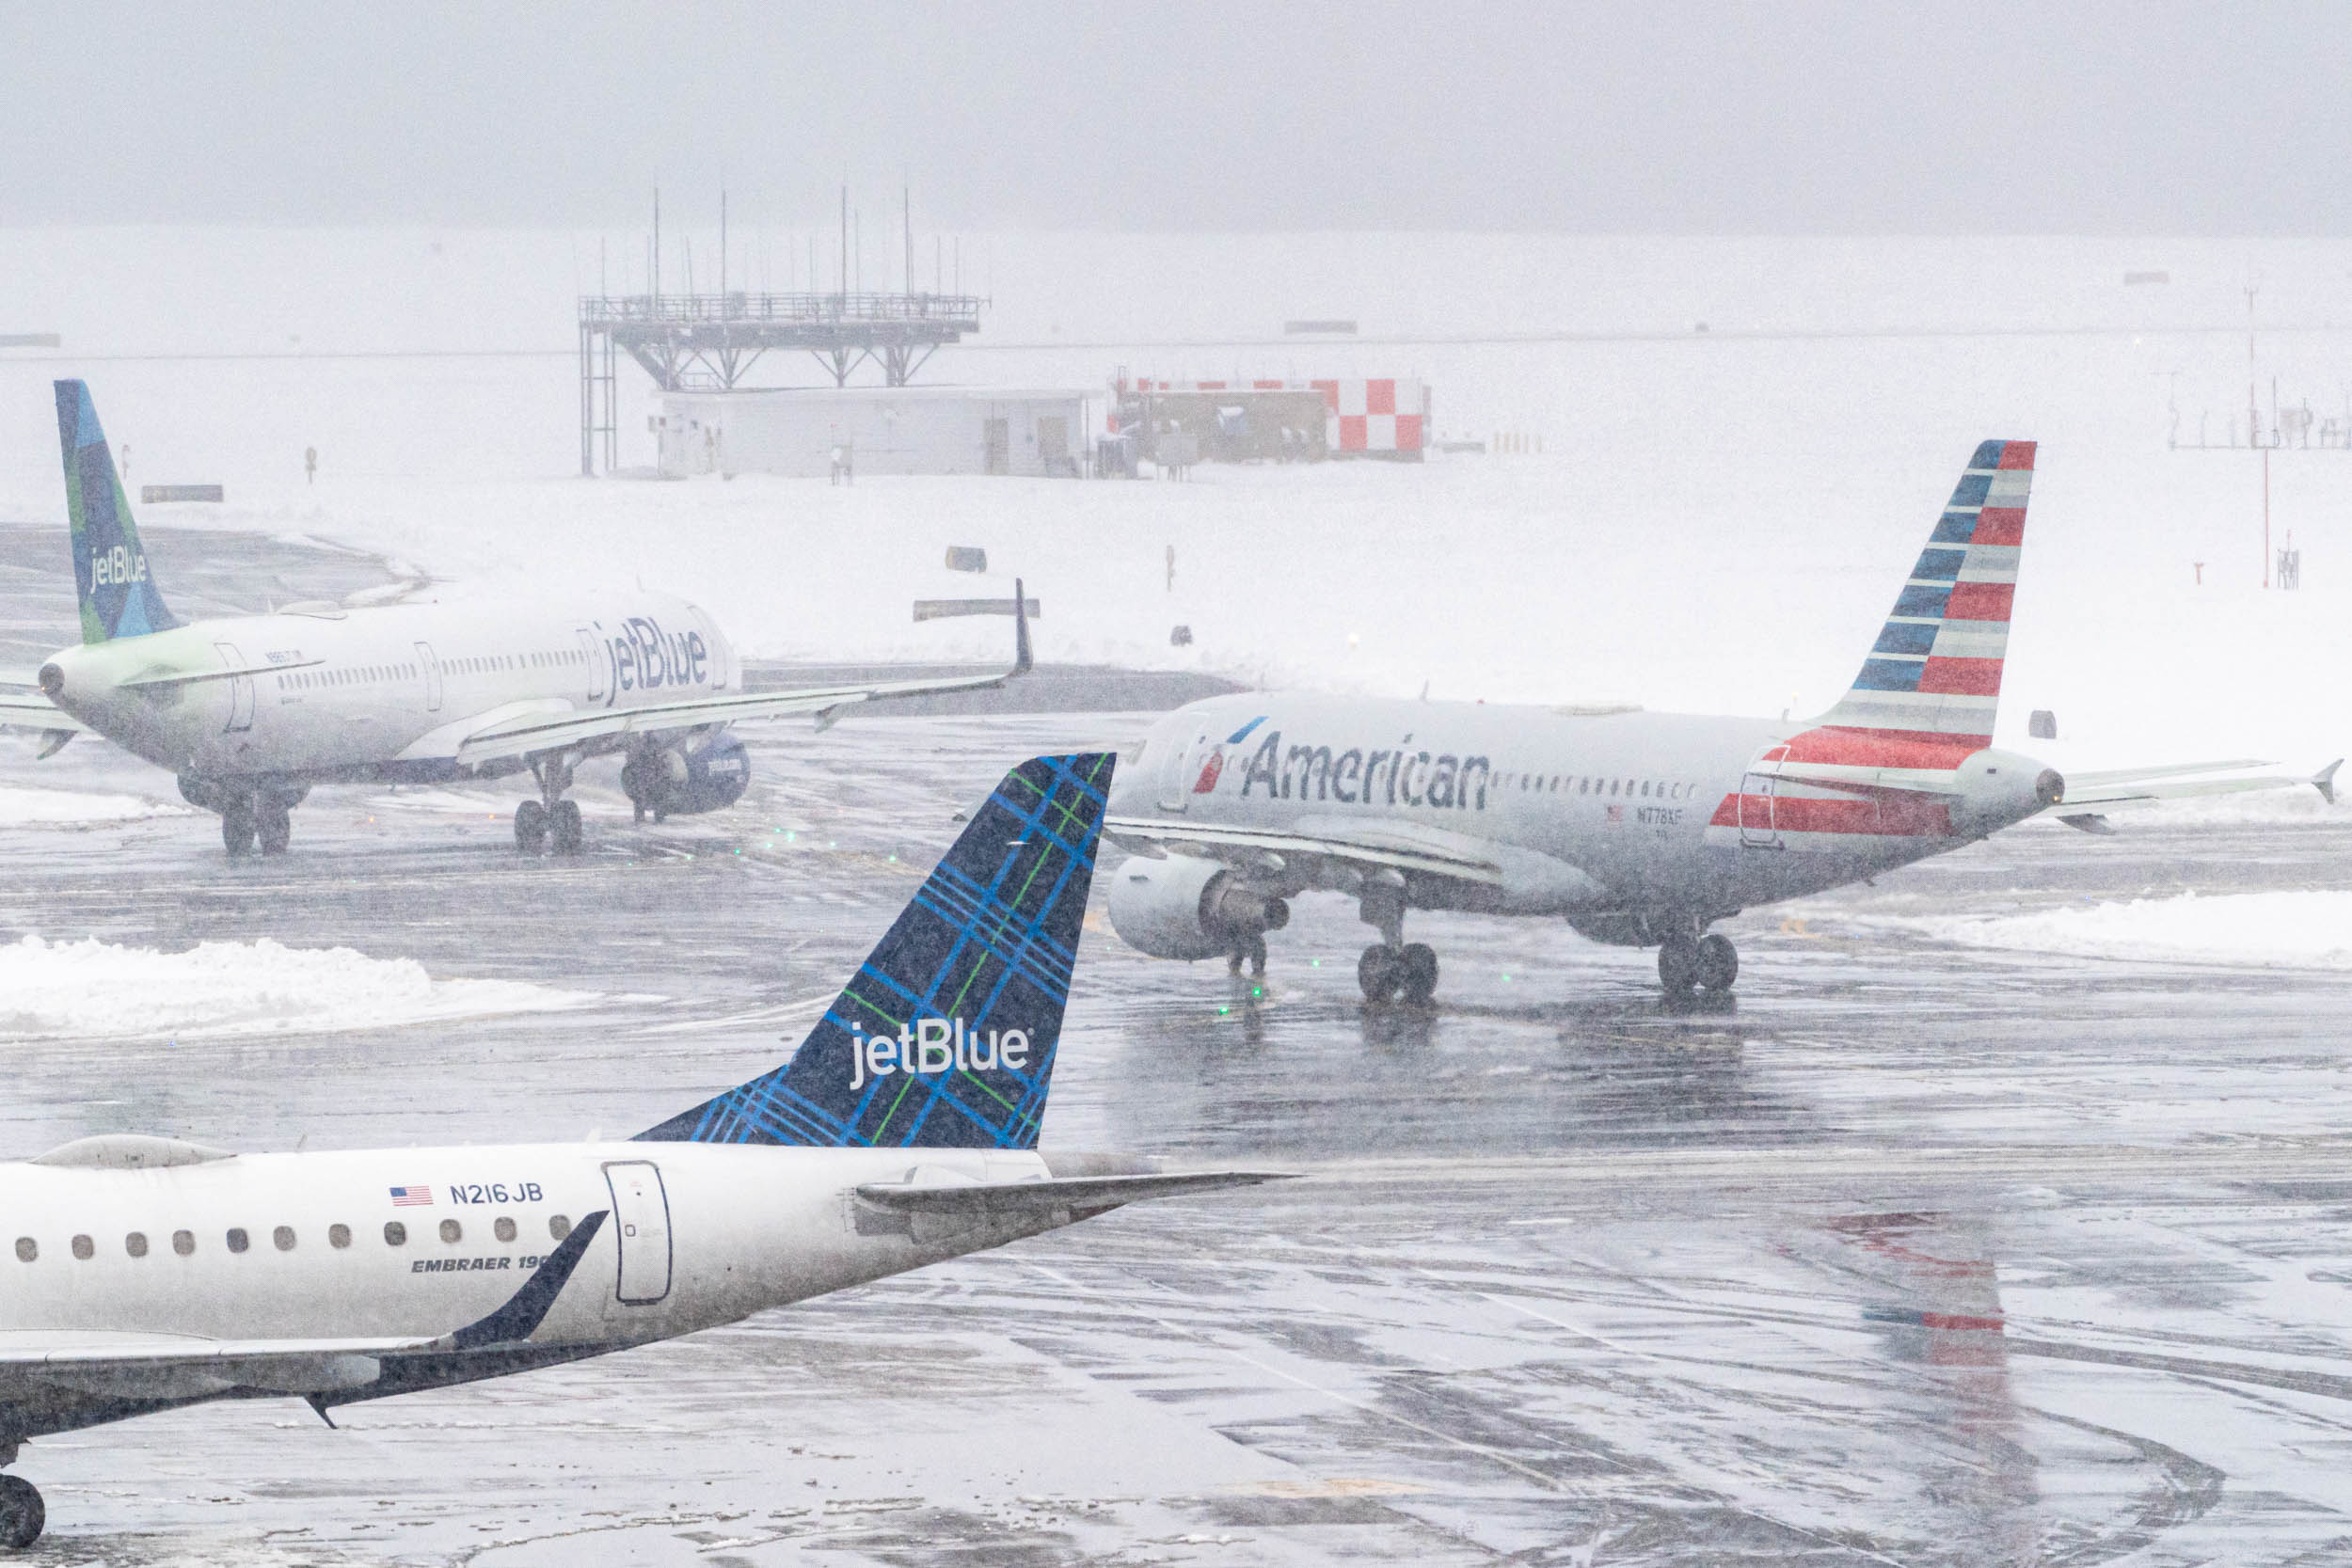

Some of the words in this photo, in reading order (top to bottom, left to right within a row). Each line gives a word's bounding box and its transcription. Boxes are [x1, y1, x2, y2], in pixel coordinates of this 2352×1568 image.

[89, 545, 147, 594] jetBlue
[593, 616, 707, 707] jetBlue
[1240, 730, 1490, 810] American
[850, 1017, 1029, 1090] jetBlue
[450, 1182, 543, 1205] N216JB
[411, 1256, 511, 1274] EMBRAER
